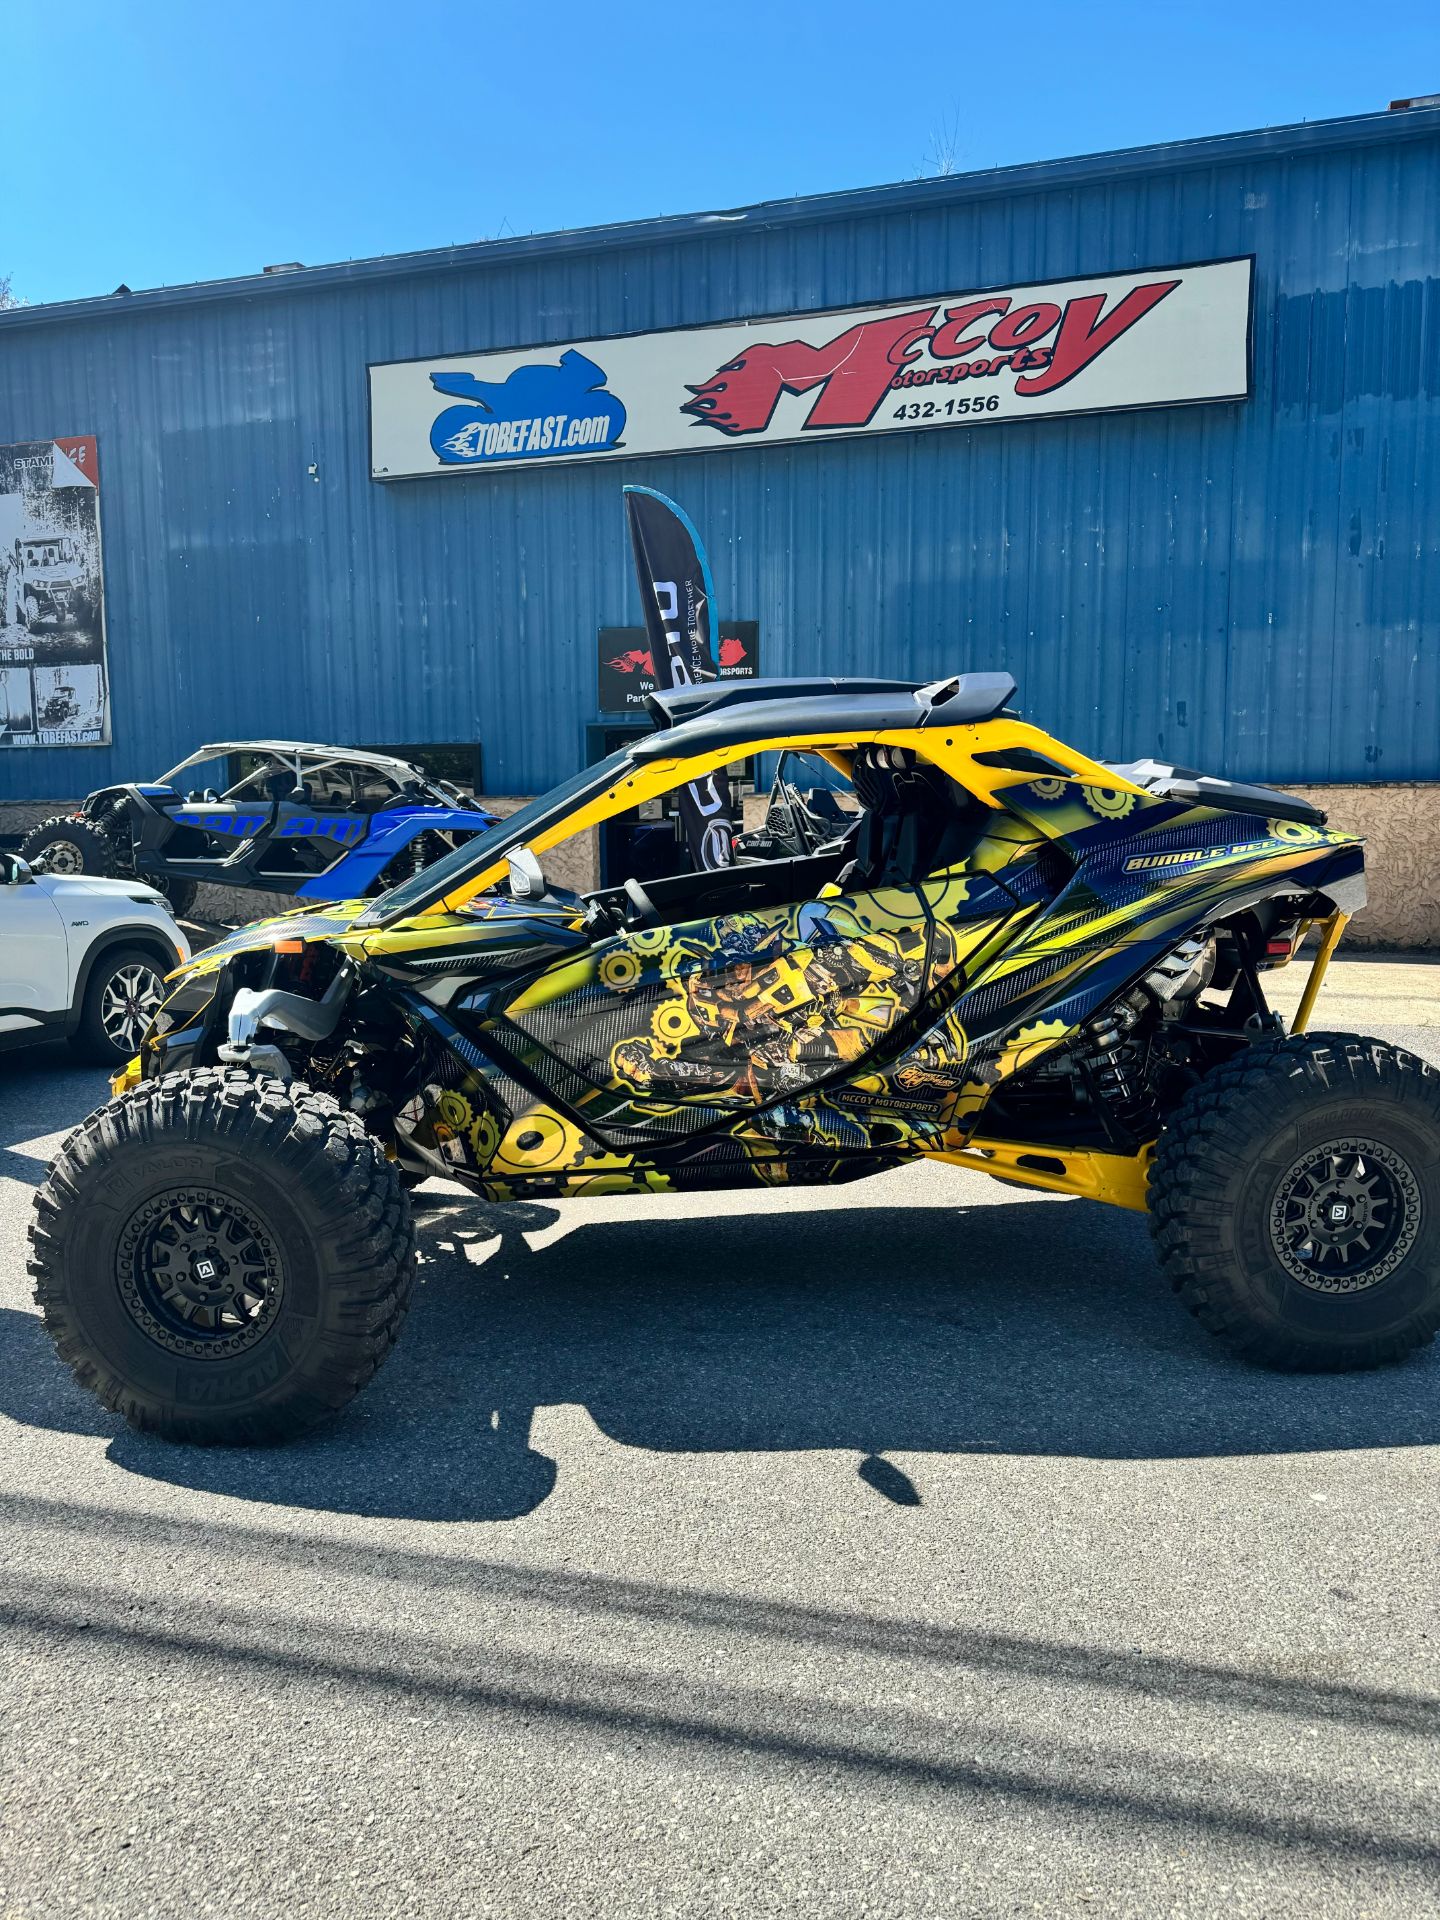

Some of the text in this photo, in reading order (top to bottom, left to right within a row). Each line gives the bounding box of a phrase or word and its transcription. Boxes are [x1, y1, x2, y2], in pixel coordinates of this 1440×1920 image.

[892, 395, 1000, 421] 432-1556
[477, 414, 610, 457] TOBEFAST.com
[14, 456, 54, 470] STAM
[685, 579, 696, 628] TOGETHER
[14, 648, 35, 660] BOLD
[688, 628, 699, 654] MORE
[640, 681, 654, 690] We
[1125, 839, 1277, 871] BUMBLE BEE
[841, 1094, 939, 1113] MCCOY MOTORSPORTS
